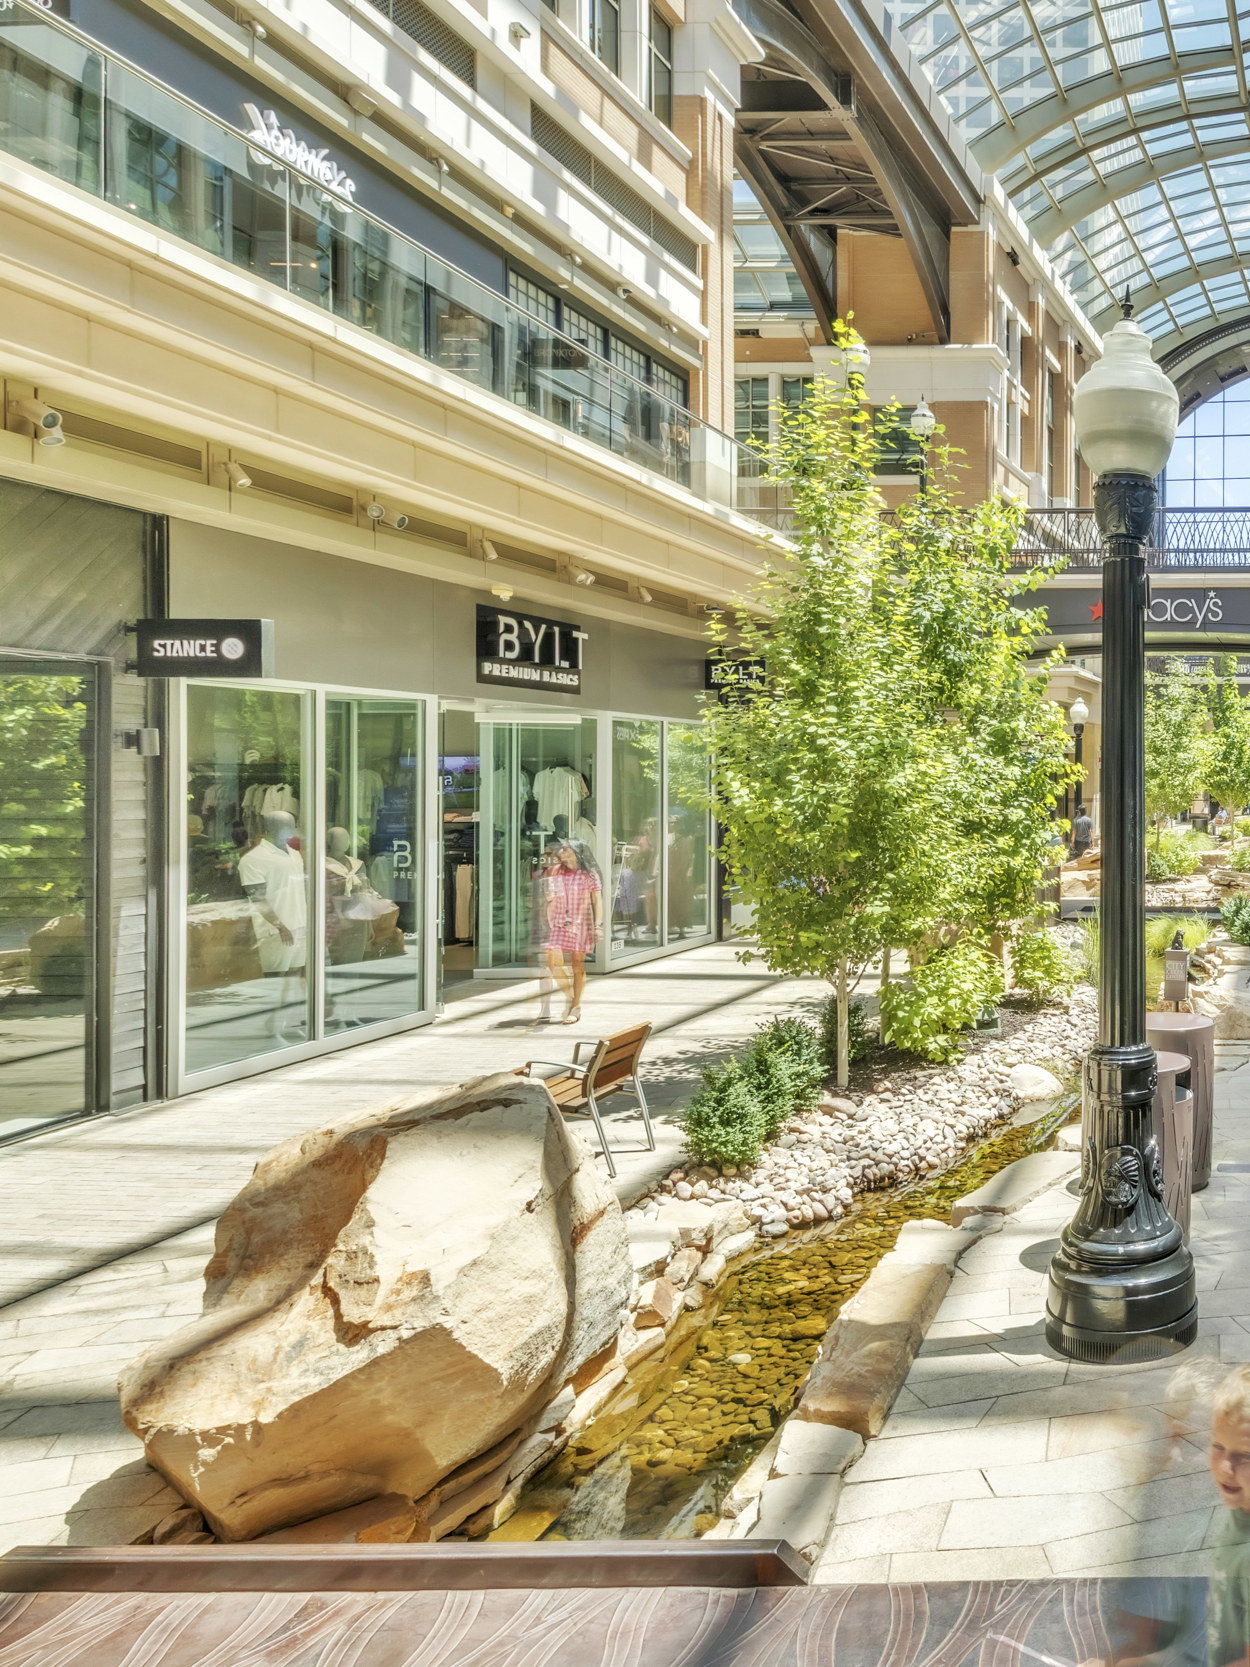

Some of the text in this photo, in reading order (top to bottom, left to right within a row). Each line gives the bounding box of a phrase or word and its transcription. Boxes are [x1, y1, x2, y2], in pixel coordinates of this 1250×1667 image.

[1144, 590, 1223, 628] acy's
[152, 639, 218, 657] STANCE
[498, 614, 588, 670] BYLT
[482, 662, 579, 686] PREMIUM BASICS
